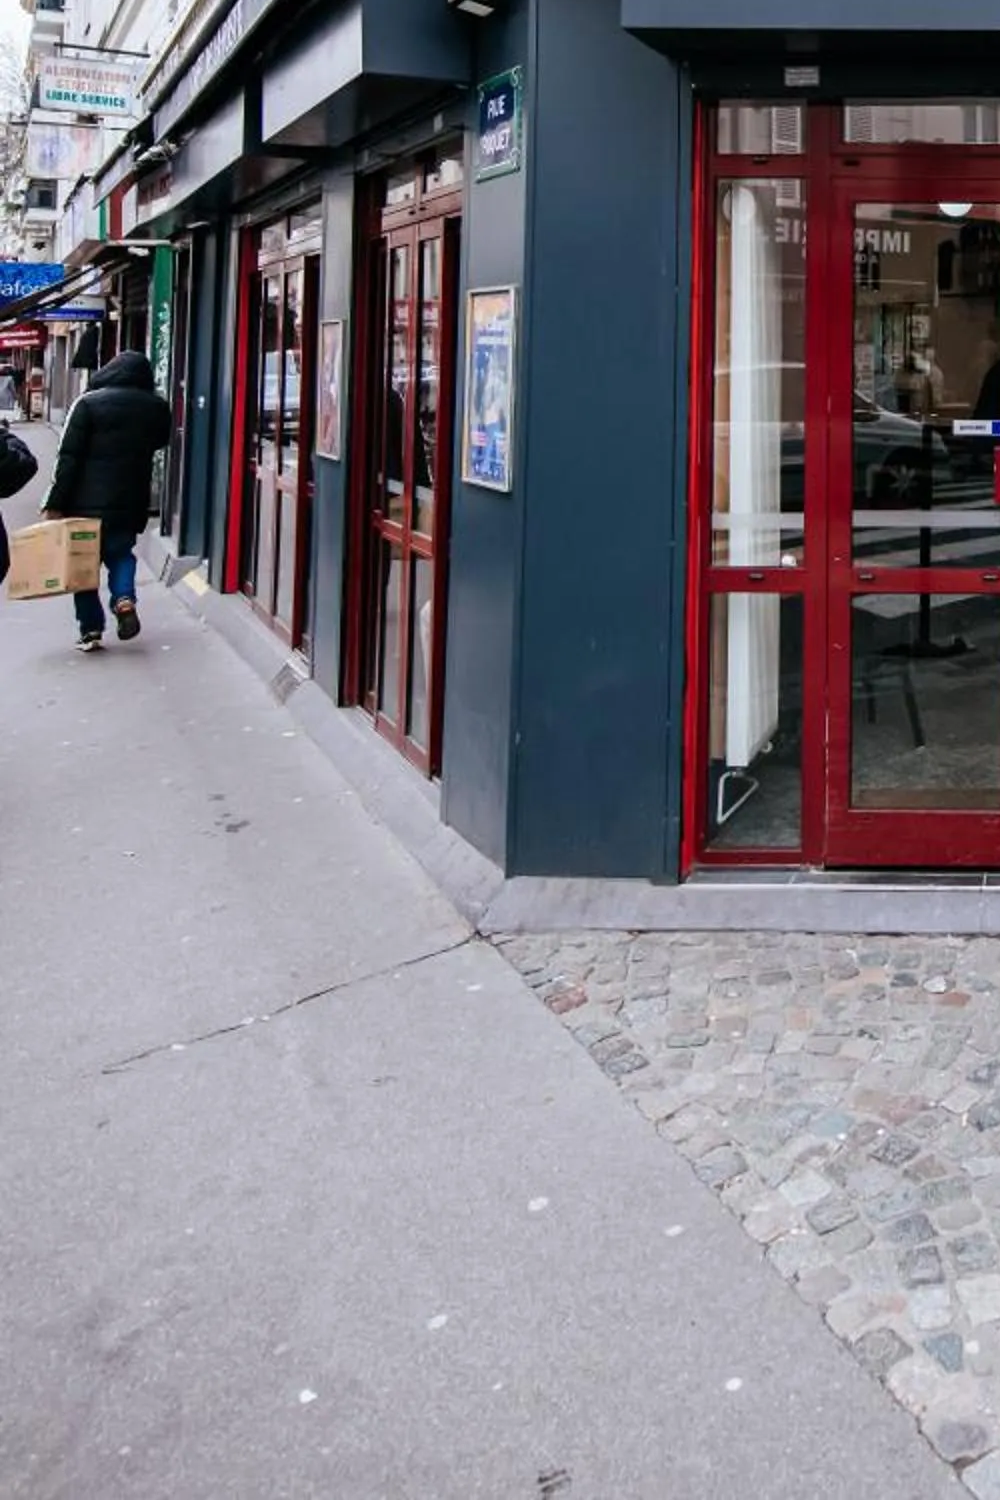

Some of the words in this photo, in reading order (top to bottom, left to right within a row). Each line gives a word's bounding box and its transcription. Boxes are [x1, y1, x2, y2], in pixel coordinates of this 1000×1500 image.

[46, 89, 78, 103] LIBRE
[80, 94, 126, 108] SERVICE
[487, 94, 506, 119] RUE
